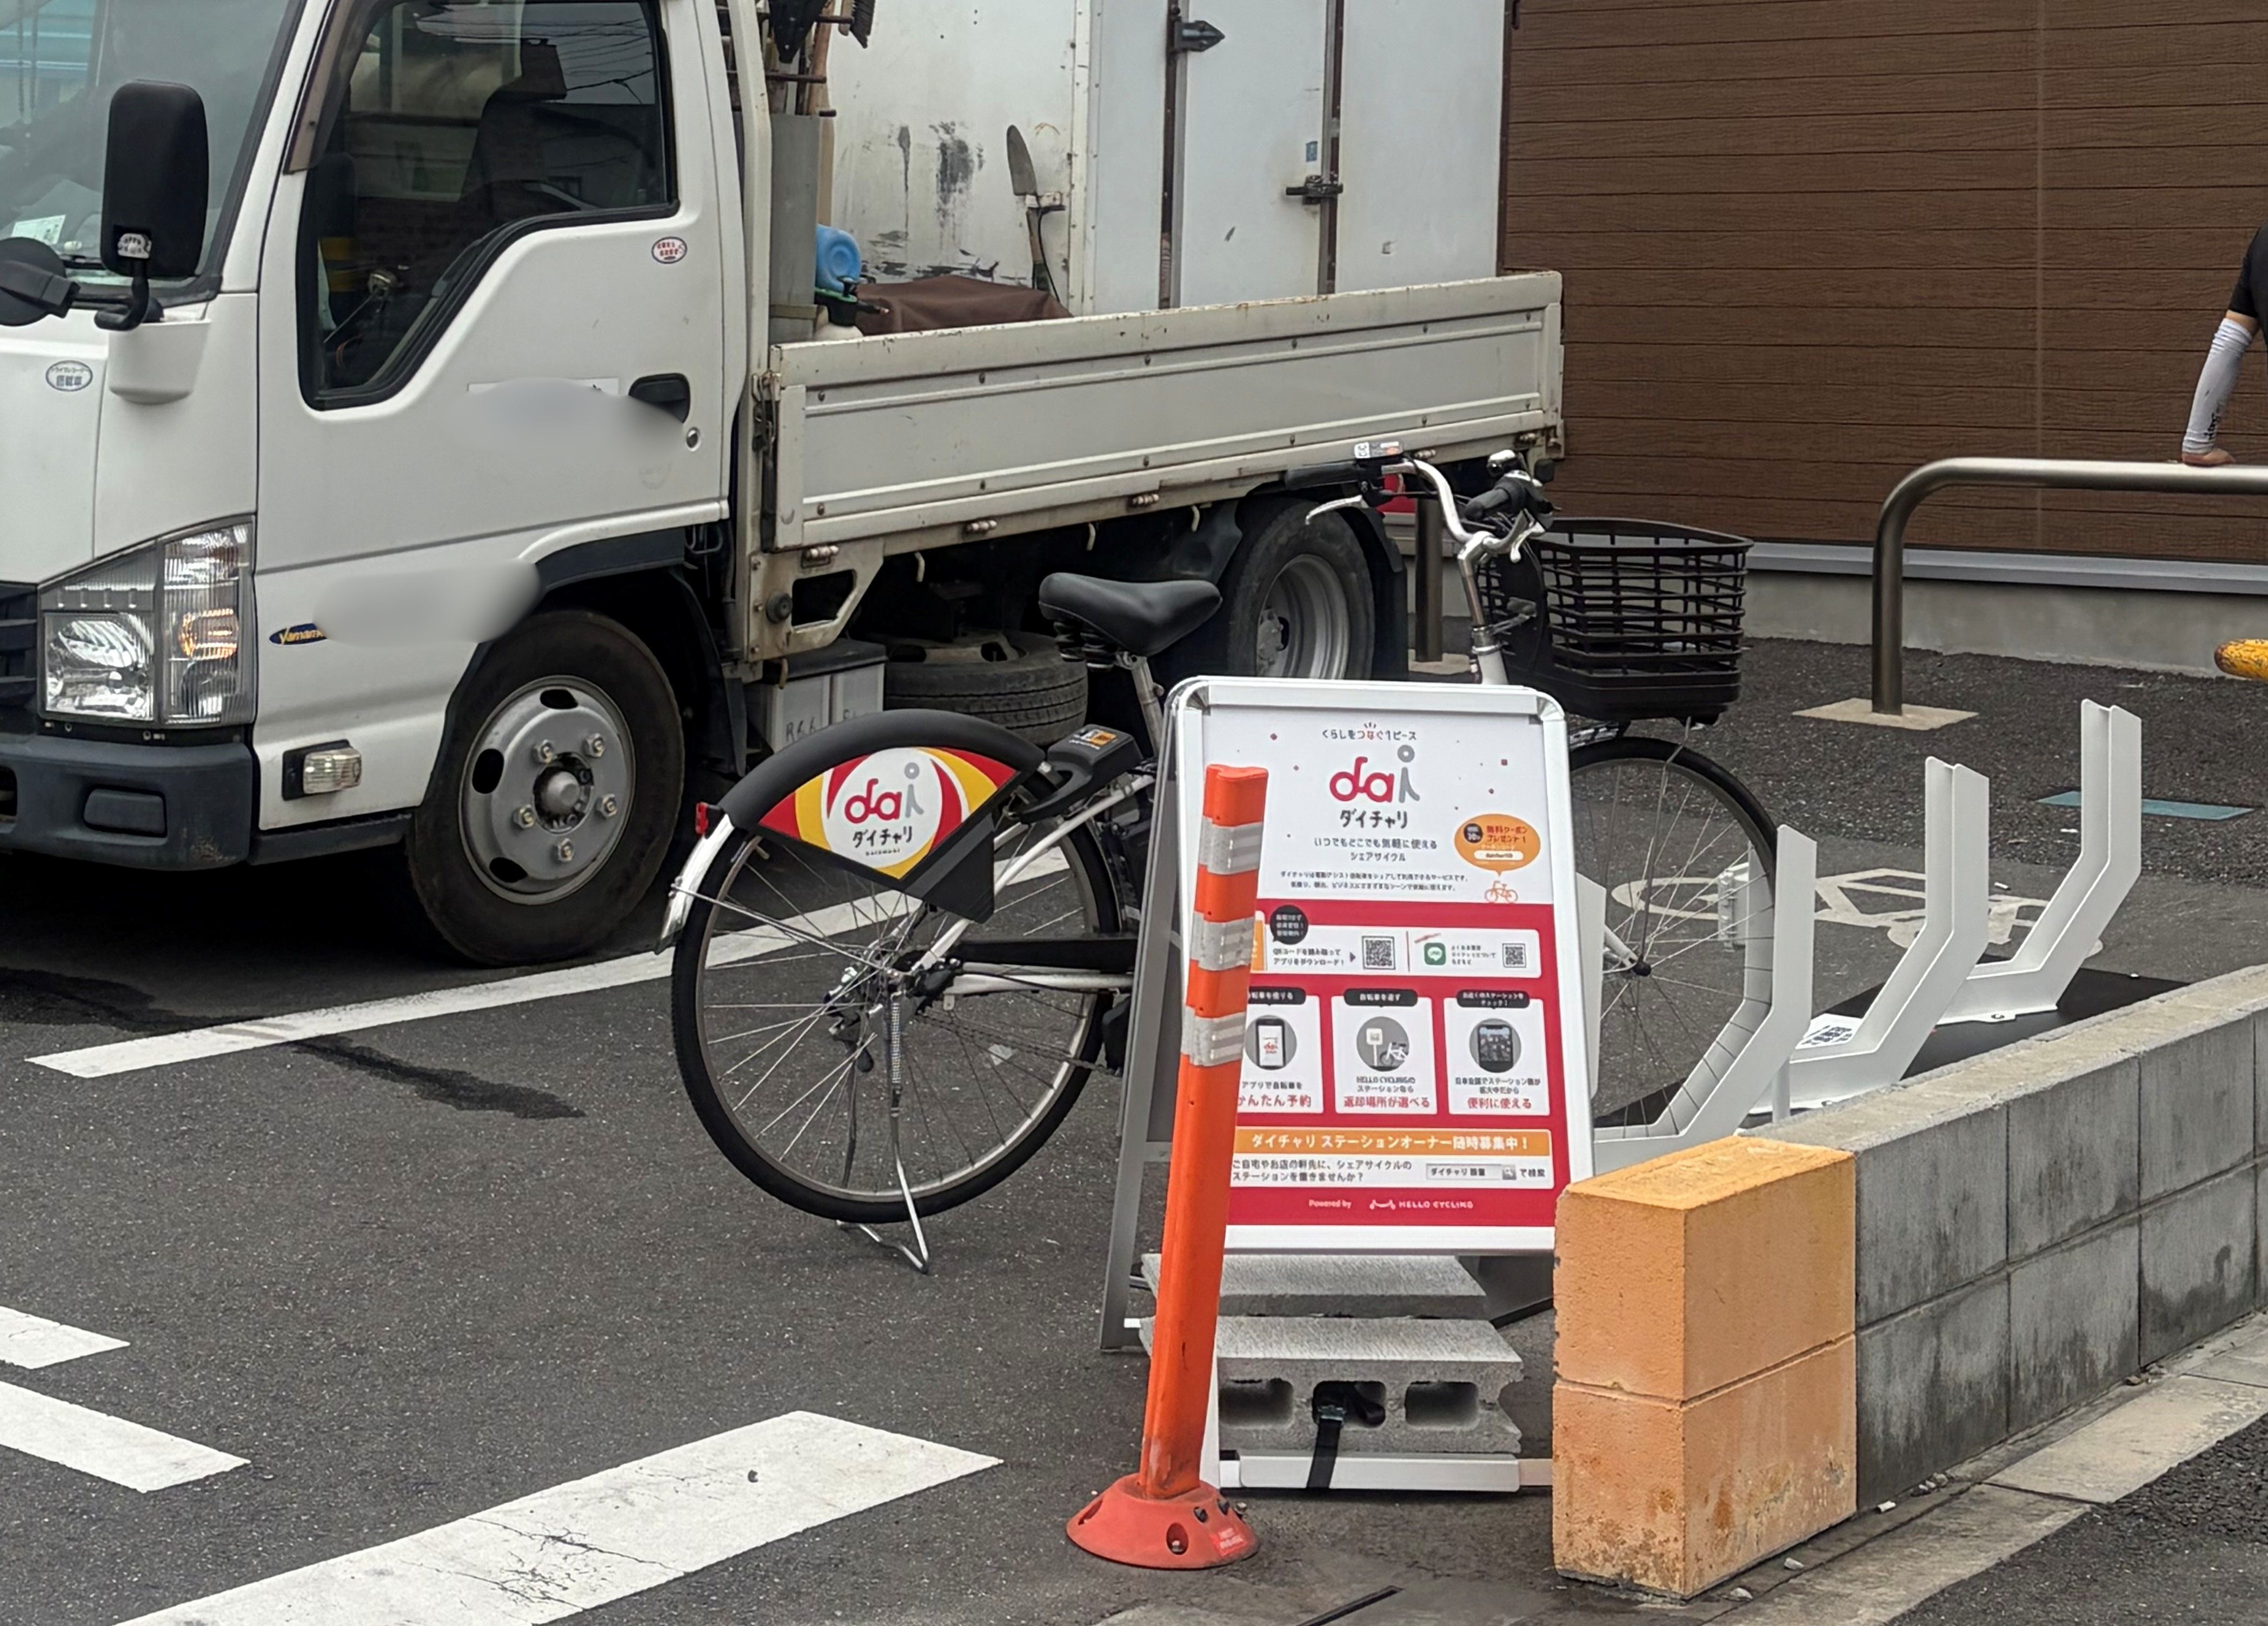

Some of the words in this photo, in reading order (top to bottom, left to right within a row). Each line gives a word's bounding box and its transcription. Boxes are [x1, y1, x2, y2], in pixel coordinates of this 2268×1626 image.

[1329, 744, 1420, 803] dai
[844, 762, 925, 824] dai
[1340, 809, 1408, 829] ダイチャリ
[853, 826, 913, 848] ダイチャリ
[1314, 837, 1437, 849] いつでもどこでも気軽に使える
[1351, 852, 1406, 862] シェアサイクル
[1248, 991, 1293, 1000] 転車を借りる
[1343, 1096, 1430, 1108] 返却場所が選べる
[1467, 1097, 1532, 1109] 便利に使える
[1252, 1134, 1316, 1148] ダイチャリ
[1232, 1159, 1412, 1170] ご自宅やお店の軒先に、シェアサイクルの
[1431, 1168, 1467, 1176] ダイチャリ
[1342, 1200, 1352, 1209] by
[1399, 1201, 1430, 1209] HELLO
[1433, 1201, 1474, 1209] CYCLING
